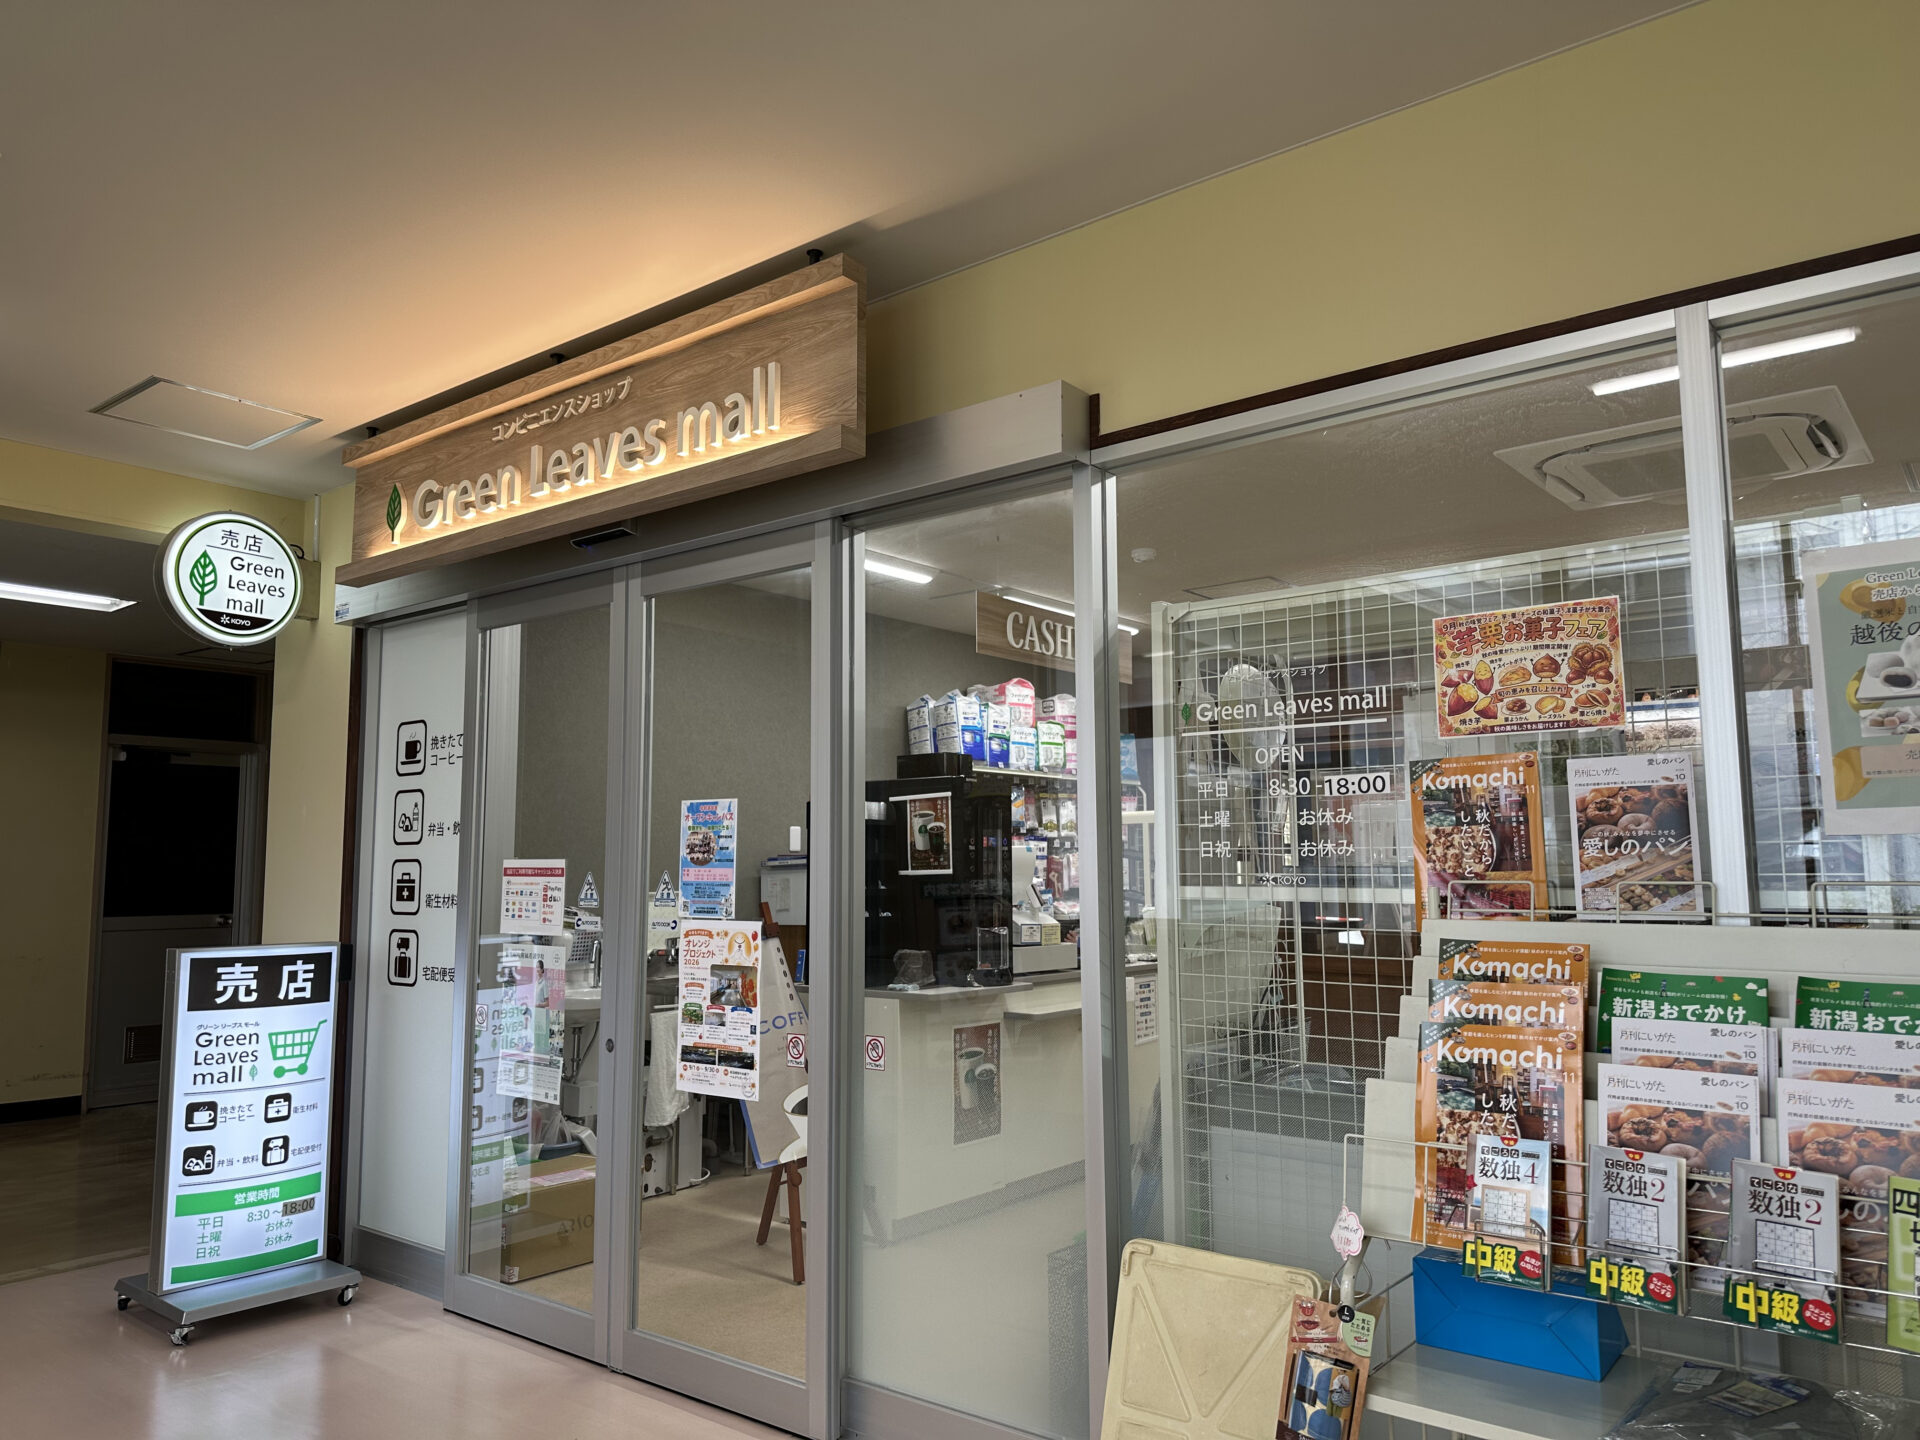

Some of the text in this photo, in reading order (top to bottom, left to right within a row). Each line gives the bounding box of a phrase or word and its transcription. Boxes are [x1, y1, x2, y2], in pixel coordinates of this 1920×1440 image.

[491, 376, 633, 443] コンビニエンスショップ
[412, 362, 781, 530] Green Leaves mall
[221, 529, 263, 554] 売店
[230, 556, 285, 580] Green
[228, 574, 285, 598] Leaves
[1866, 572, 1904, 584] Green
[226, 598, 264, 615] mall
[231, 618, 251, 626] KOYO
[1452, 616, 1607, 656] 芋栗お菓子フェア
[1196, 685, 1387, 722] Green Leaves mall
[1459, 717, 1482, 726] 焼き芋
[431, 733, 464, 750] 挽きたて
[1255, 746, 1305, 765] OPEN
[1647, 757, 1685, 766] 愛しのパン
[1422, 766, 1524, 791] Komachi
[1574, 767, 1620, 778] 月刊にいがた
[1198, 781, 1229, 798] 平日
[1525, 785, 1535, 794] 11
[1199, 808, 1354, 828] 土曜 お休み
[1476, 809, 1492, 865] 秋だから
[1201, 839, 1355, 858] 日祝 お休み
[1583, 837, 1690, 858] 愛しのパン
[1278, 876, 1306, 885] KOYO
[685, 939, 710, 948] オレンジ
[683, 949, 716, 959] プロジェクト
[1453, 954, 1571, 980] Komachi
[215, 960, 315, 1004] 売店
[1444, 996, 1565, 1024] Komachi
[1612, 996, 1747, 1024] 新潟おでかけ
[195, 1031, 259, 1048] Green
[1619, 1030, 1676, 1043] 月刊にいがた
[1710, 1028, 1757, 1039] 愛しのパン
[1437, 1039, 1563, 1070] Komachi
[1744, 1051, 1757, 1059] 10
[1792, 1042, 1856, 1056] 月刊にいがた
[194, 1050, 258, 1066] Leaves
[193, 1065, 242, 1085] mall
[1562, 1072, 1575, 1083] 11
[1701, 1077, 1749, 1088] 愛しのパン
[1606, 1077, 1666, 1092] 月刊にいがた
[219, 1104, 254, 1115] 挽きたて
[1735, 1102, 1749, 1110] 10
[1787, 1093, 1855, 1110] 月刊にいがた
[219, 1114, 255, 1123] コーヒー
[291, 1143, 322, 1157] 宅配便受付
[217, 1156, 259, 1168] 弁当・飲料
[234, 1187, 280, 1205] 営業時間
[198, 1215, 224, 1229] 平日
[197, 1218, 293, 1245] 土曜 お休み
[196, 1233, 293, 1259] 日祝 お休み
[1466, 1239, 1516, 1275] 中級
[1590, 1257, 1644, 1297] 中級
[1652, 1277, 1673, 1292] ちょっと
[1344, 1307, 1349, 1315] L
[1736, 1282, 1799, 1325] 中級
[1808, 1304, 1832, 1319] ちょっと
